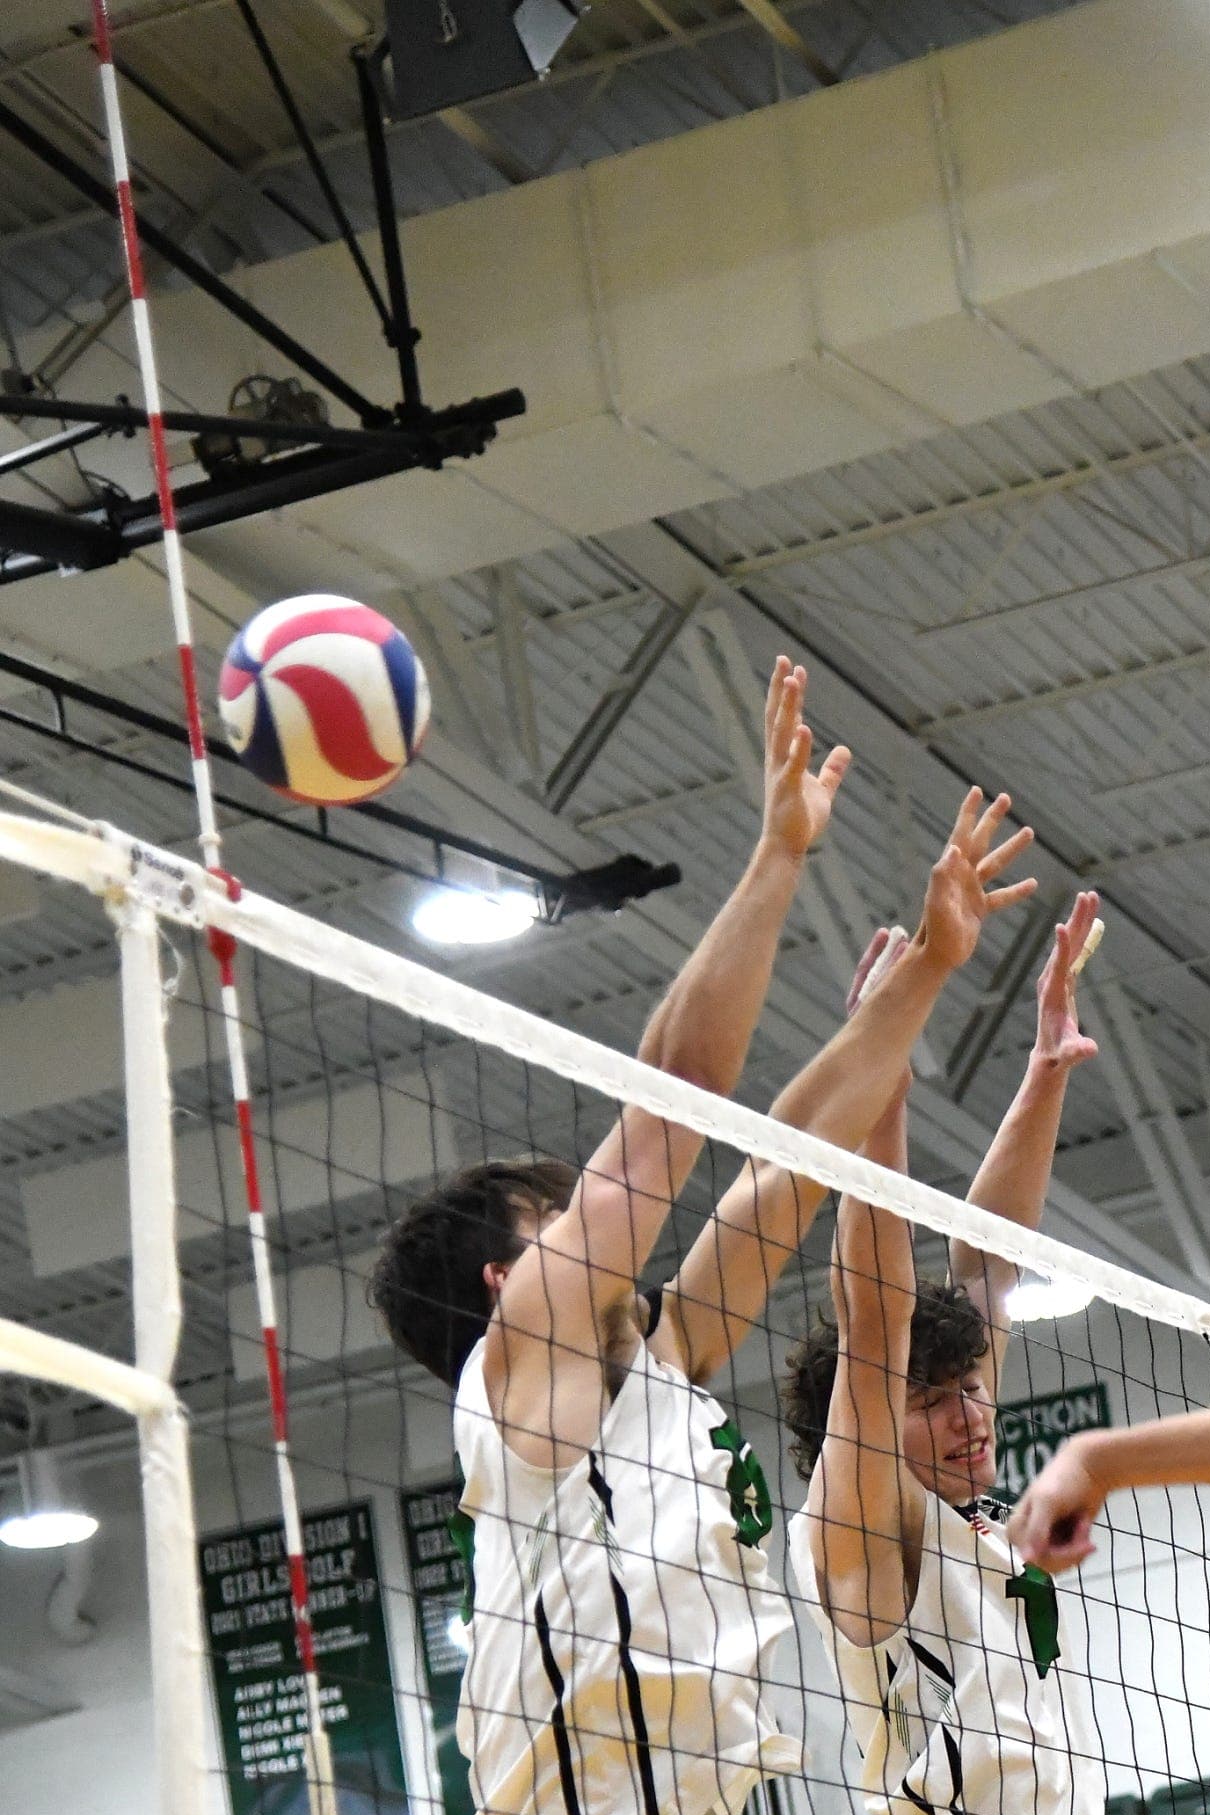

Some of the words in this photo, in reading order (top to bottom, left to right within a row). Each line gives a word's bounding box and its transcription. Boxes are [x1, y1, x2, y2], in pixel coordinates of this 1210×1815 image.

[997, 1394, 1099, 1443] CTION
[221, 1564, 291, 1604] GIRLS
[304, 1549, 355, 1583] OLF
